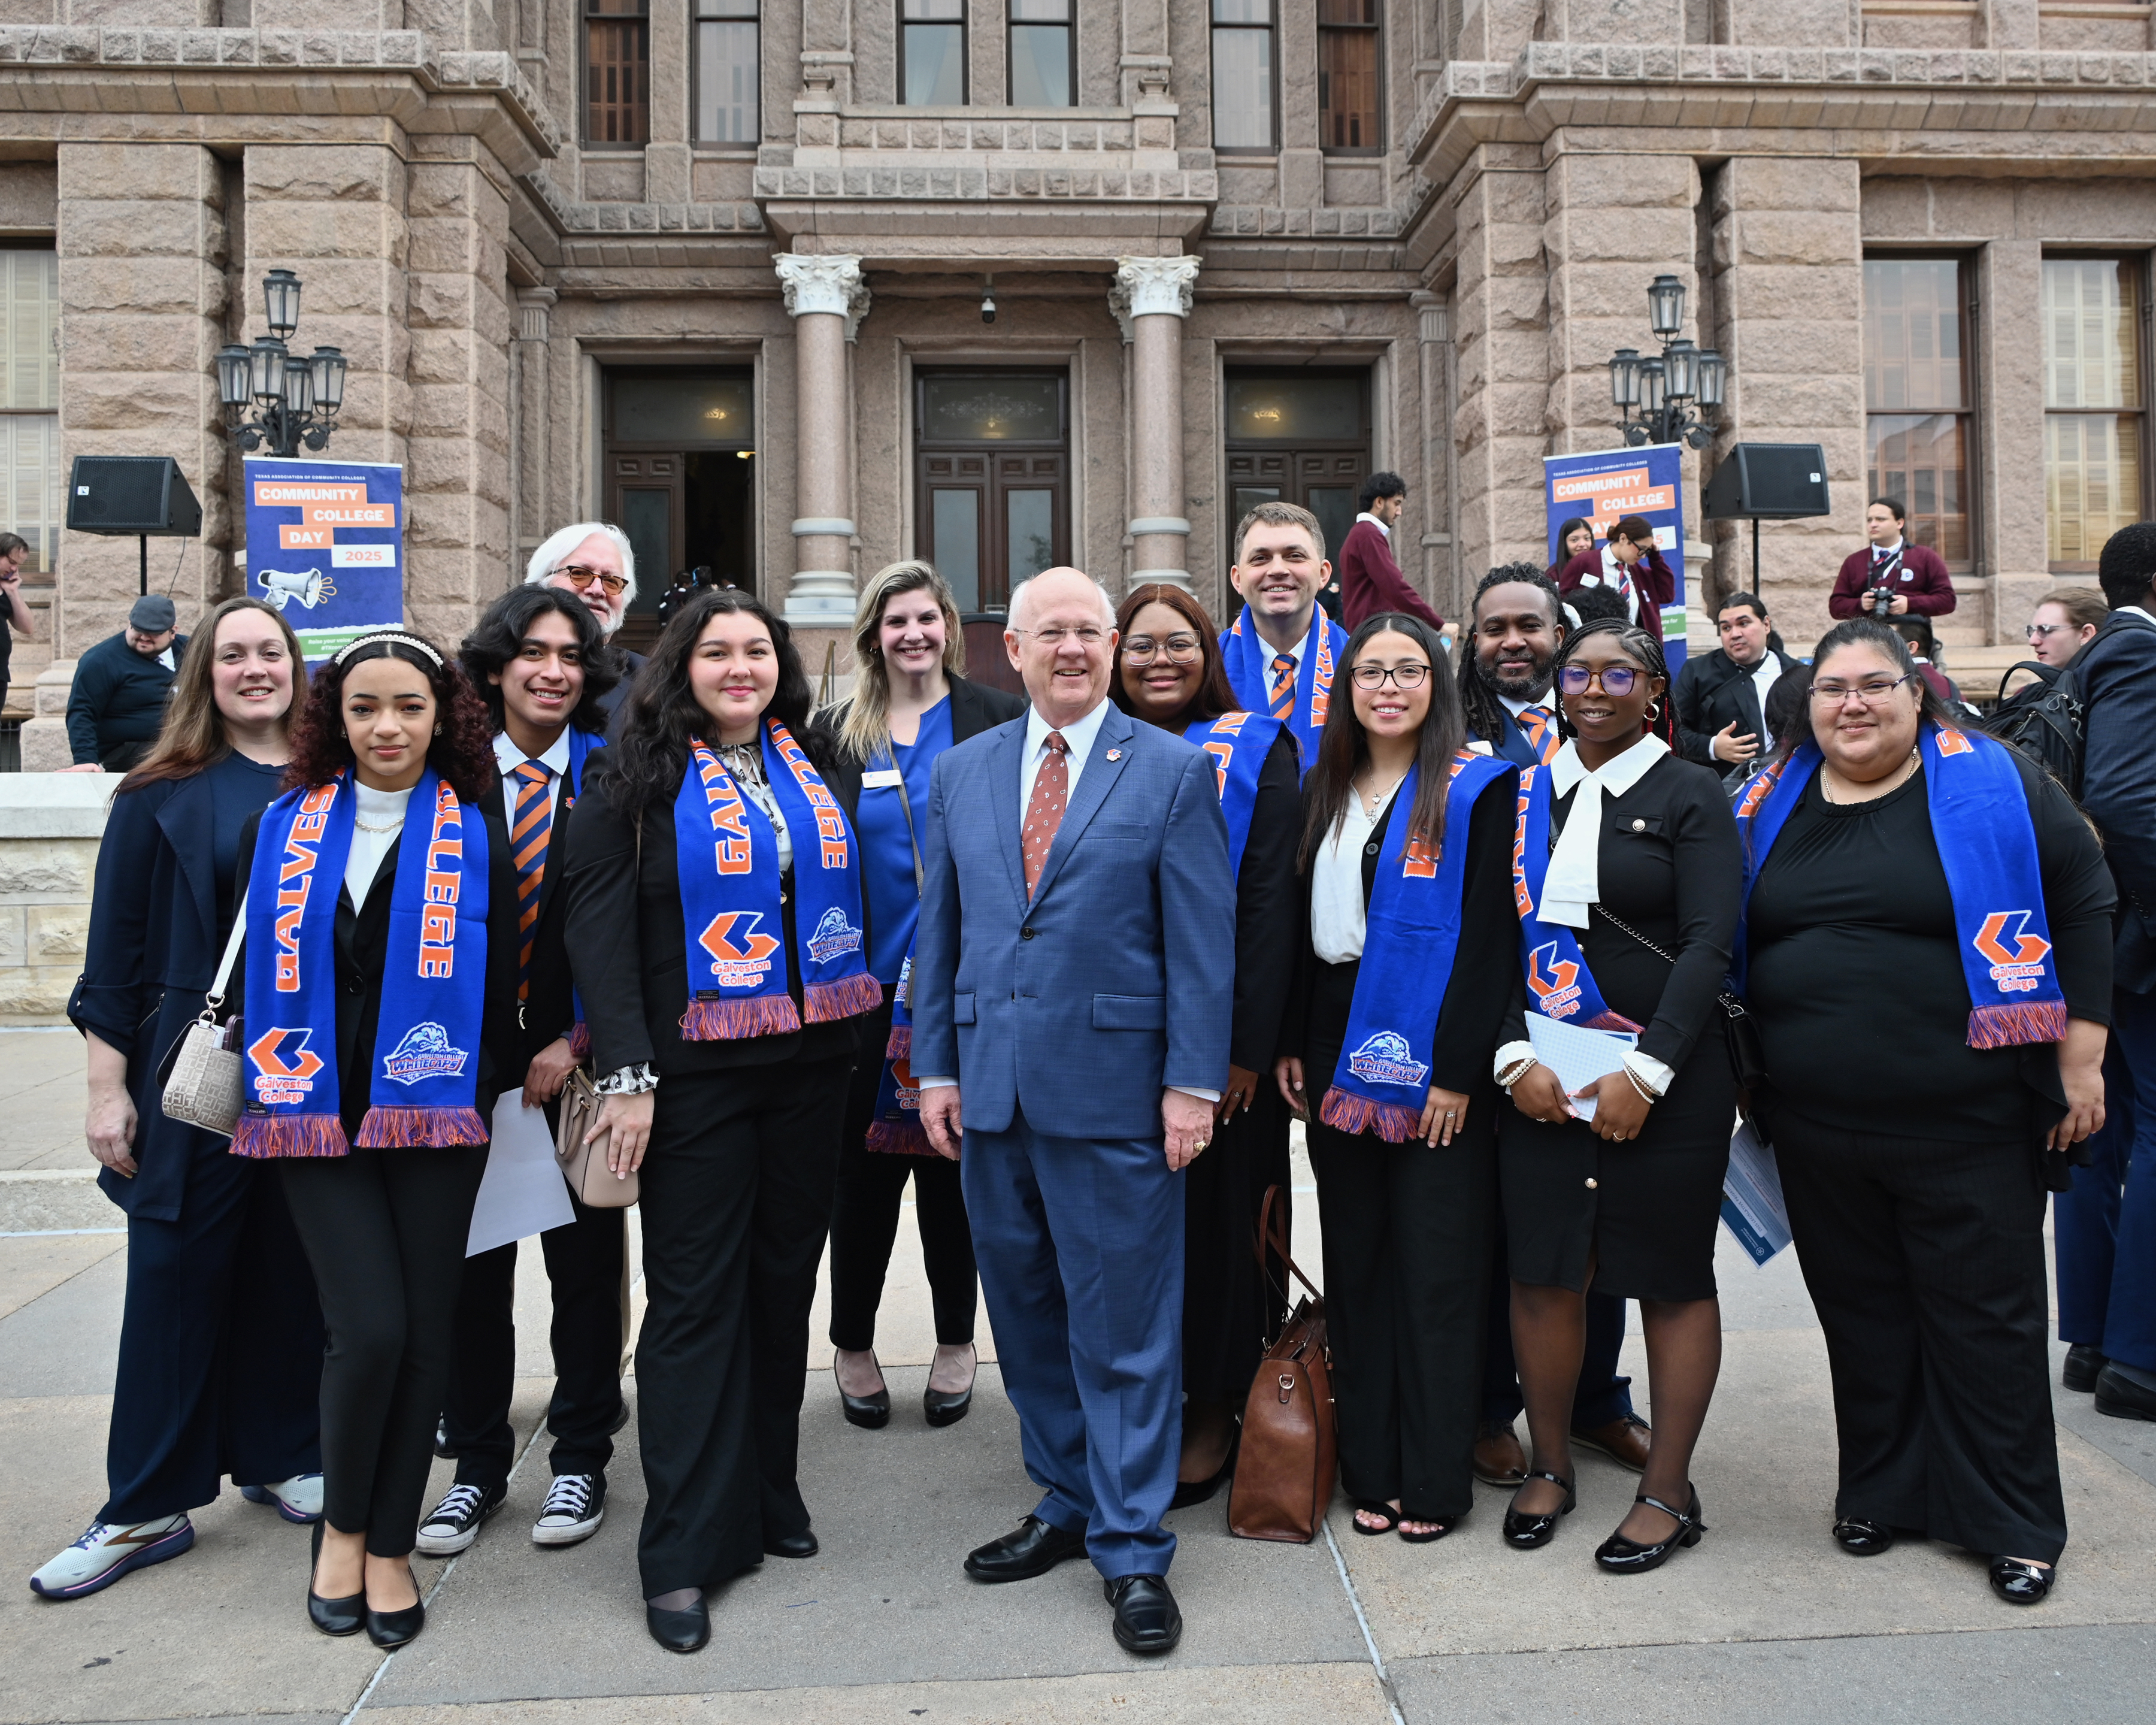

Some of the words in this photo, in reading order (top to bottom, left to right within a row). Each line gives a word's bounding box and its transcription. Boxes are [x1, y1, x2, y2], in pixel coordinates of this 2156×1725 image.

[1557, 474, 1641, 497] COMMUNITY
[259, 488, 358, 501] COMMUNITY
[1602, 492, 1665, 511] COLLEGE
[313, 510, 384, 522] COLLEGE
[290, 532, 323, 543] DAY
[346, 551, 382, 561] 2025
[713, 961, 770, 973] Galveston
[1991, 966, 2043, 979] Galveston
[720, 975, 762, 985] College
[2000, 978, 2036, 991] College
[1540, 987, 1580, 1010] Galveston
[1550, 1001, 1579, 1019] College
[392, 1058, 459, 1074] WHITECAPS
[255, 1077, 312, 1090] Galveston
[261, 1091, 303, 1103] College
[1737, 1201, 1756, 1224] LEGISLATIVE
